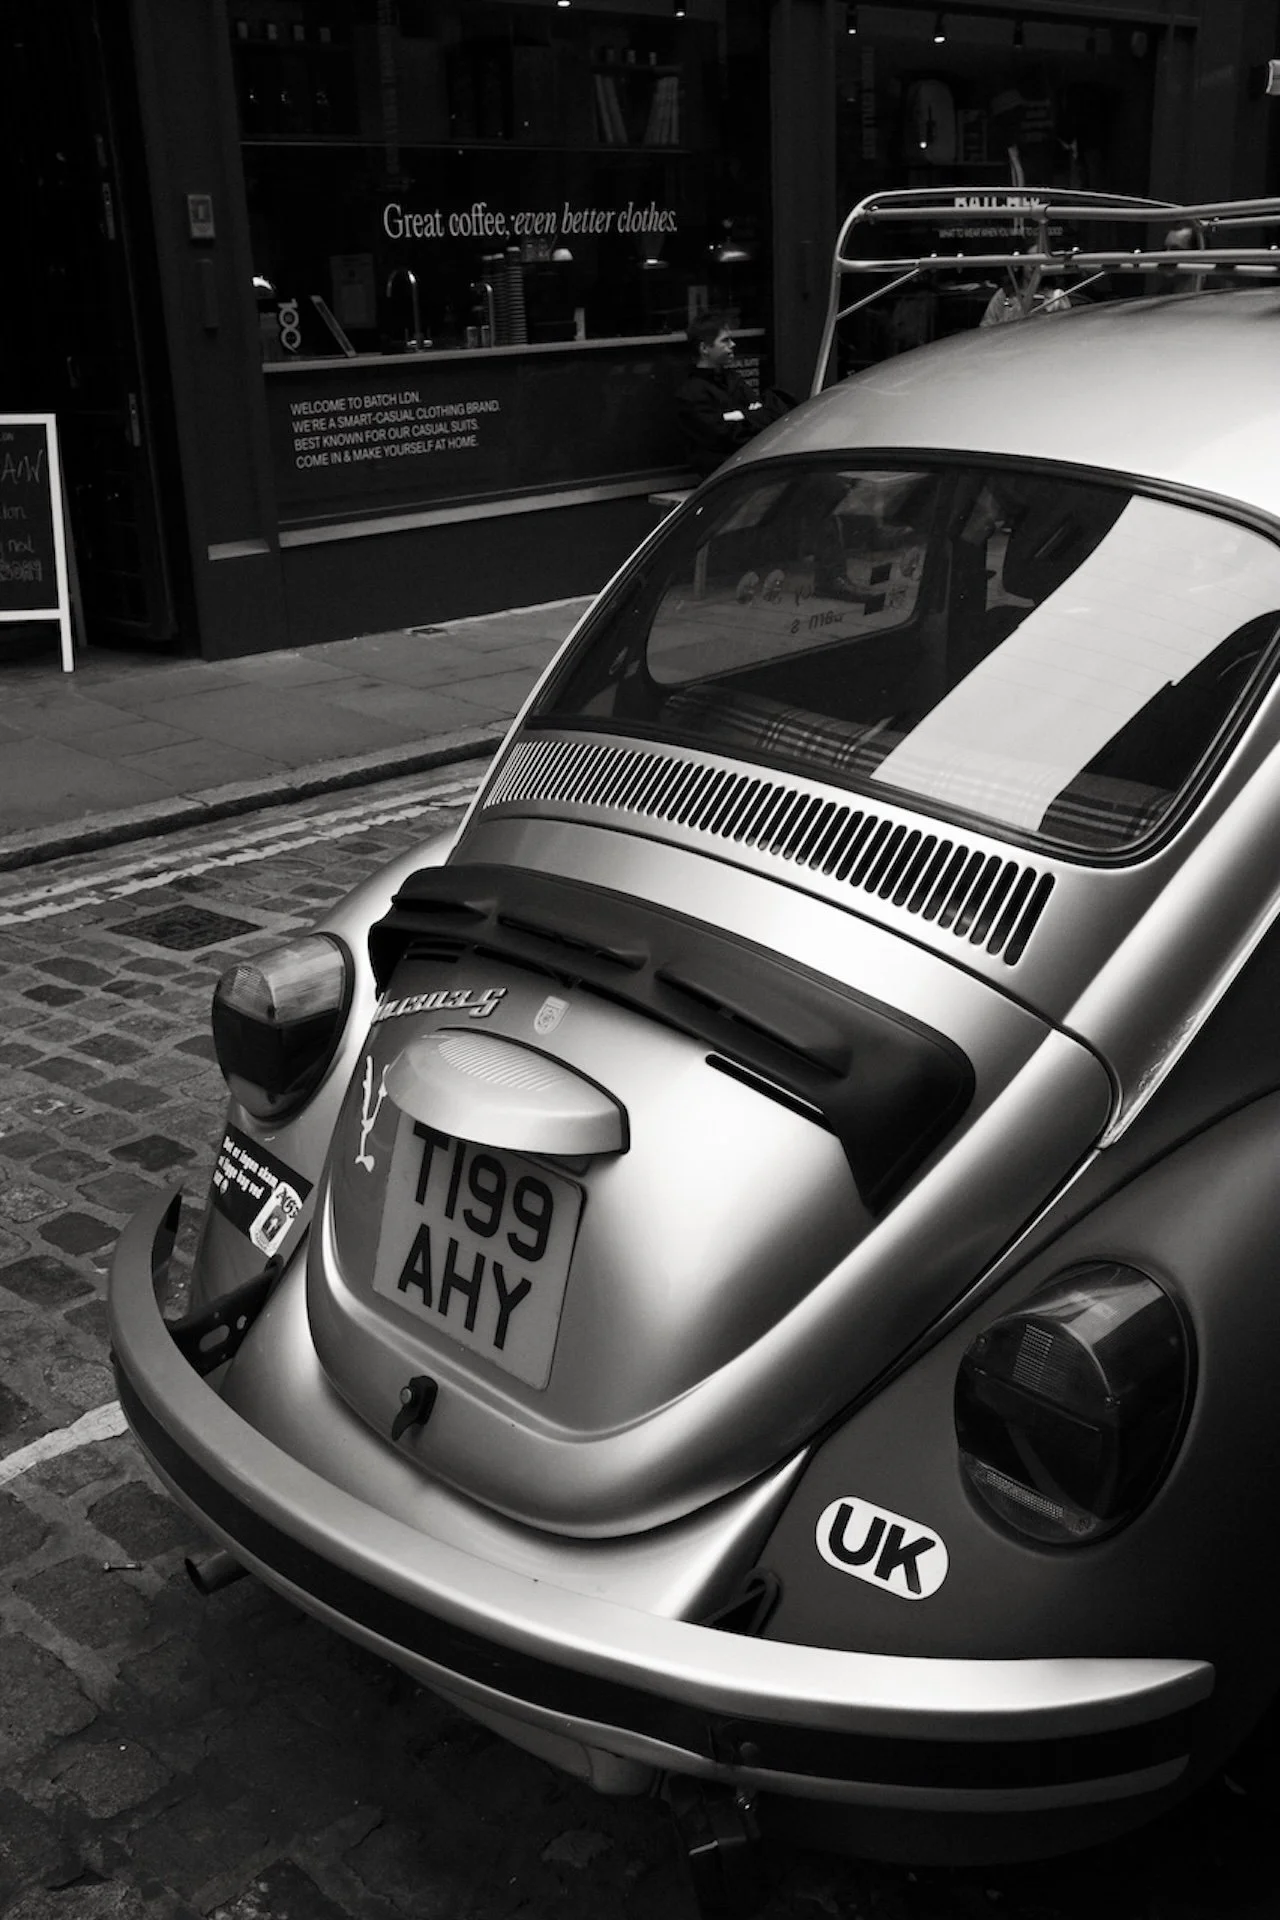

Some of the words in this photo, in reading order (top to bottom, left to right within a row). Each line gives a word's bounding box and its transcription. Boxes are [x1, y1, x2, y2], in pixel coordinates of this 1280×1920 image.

[383, 203, 443, 239] Great
[450, 202, 512, 241] coffee,
[513, 209, 558, 236] even
[561, 202, 616, 235] better
[617, 201, 678, 234] clothes.
[290, 398, 346, 416] WELCOME
[347, 396, 363, 409] TO
[364, 393, 399, 407] BATCH
[399, 391, 421, 405] LDN.
[292, 416, 328, 433] WE'RE
[328, 416, 338, 429] A
[338, 409, 415, 429] SMART-CASUAL
[416, 404, 465, 420] CLOTHING
[466, 399, 500, 414] BRAND.
[294, 436, 321, 451] BEST
[322, 432, 364, 449] KNOWN
[364, 429, 387, 443] FOR
[387, 427, 410, 441] OUR
[412, 421, 450, 437] CASUAL
[451, 418, 480, 433] SUITS.
[296, 453, 329, 469] COME
[331, 451, 342, 464] IN
[343, 450, 351, 463] &
[352, 446, 382, 461] MAKE
[384, 439, 435, 457] YOURSELF
[435, 439, 447, 452] AT
[448, 434, 480, 449] HOME.
[413, 1119, 554, 1262] T199
[397, 1222, 532, 1350] AHY
[828, 1502, 937, 1595] UK
